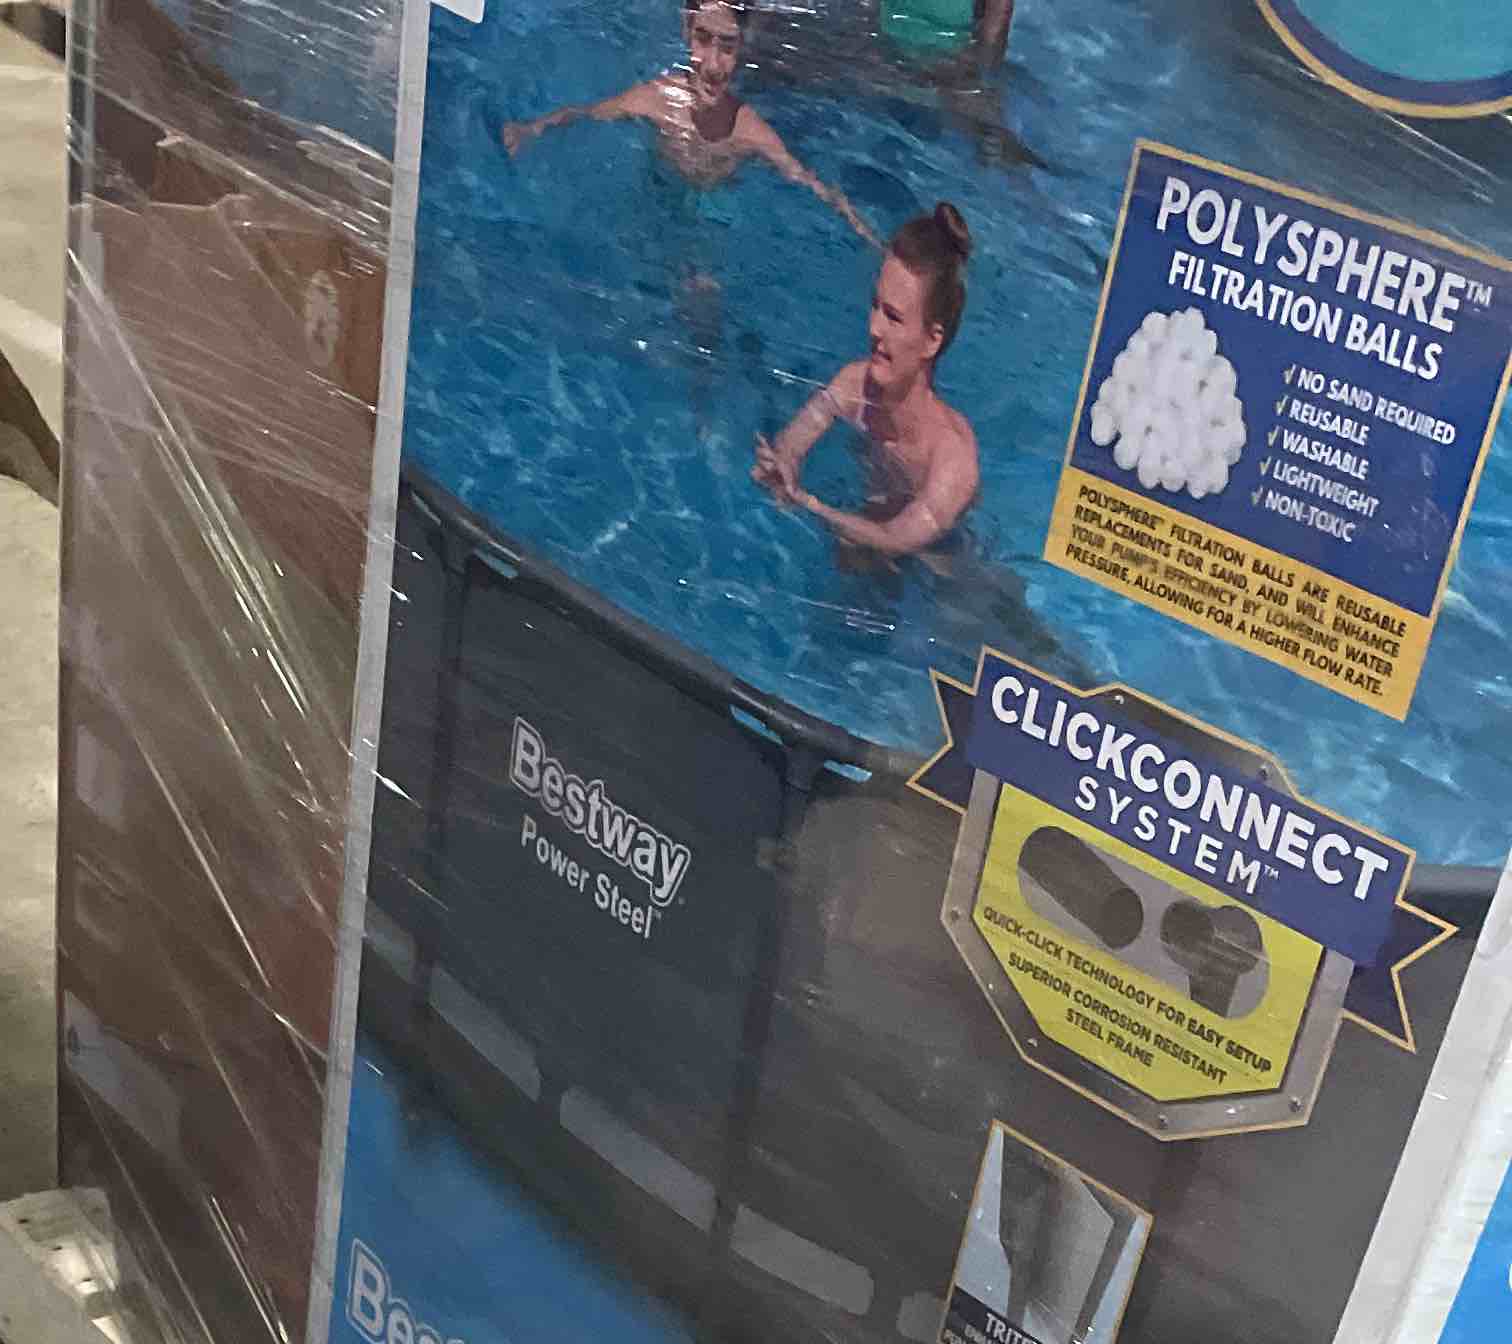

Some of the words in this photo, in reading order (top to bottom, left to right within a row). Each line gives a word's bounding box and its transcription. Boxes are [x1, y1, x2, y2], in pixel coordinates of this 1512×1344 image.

[1168, 250, 1342, 344] FILTRATION
[1345, 313, 1442, 380] BALLS
[1282, 429, 1369, 480] WASHABLE
[1289, 399, 1370, 445] REUSABLE
[1297, 367, 1325, 394] NO
[1326, 379, 1373, 412] SAND
[1374, 396, 1456, 445] REQUIRED
[1265, 489, 1356, 542] NON-TOXIC
[1273, 459, 1380, 518] LIGHTWEIGHT
[1065, 543, 1130, 584] PRESSURE,
[1134, 575, 1204, 615] ALLOWING
[1206, 605, 1234, 629] FOR
[1236, 620, 1247, 635] A
[1249, 623, 1301, 658] HIGHER
[1303, 648, 1343, 677] FLOW
[1344, 667, 1384, 697] RATE.
[1071, 523, 1106, 549] YOUR
[1242, 599, 1260, 617] BY
[1265, 609, 1339, 652] LOWERING
[1345, 643, 1394, 678] WATER
[1074, 504, 1173, 557] REPLACEMENTS
[1176, 548, 1204, 572] FOR
[1256, 584, 1289, 607] AND
[1295, 597, 1326, 625] WILL
[1332, 616, 1400, 658] ENHANCE
[1170, 524, 1245, 567] FILTRATION
[1252, 559, 1295, 588] BALLS
[1302, 581, 1330, 602] ARE
[1336, 595, 1407, 638] REUSABLE
[511, 717, 691, 906] Bestway
[991, 675, 1390, 900] CLICKCONNECT
[521, 814, 591, 894] Power
[983, 906, 1065, 960] QUICK-CLICK
[1066, 950, 1155, 1011] TECHNOLOGY
[1156, 1000, 1186, 1027] FOR
[1188, 1018, 1226, 1050] EASY
[1225, 1039, 1272, 1074] SETUP
[1007, 951, 1072, 999] SUPERIOR
[1073, 988, 1153, 1042] CORROSION
[1153, 1033, 1228, 1086] RESISTANT
[1065, 1007, 1105, 1041] STEEL
[1107, 1031, 1155, 1068] FRAME
